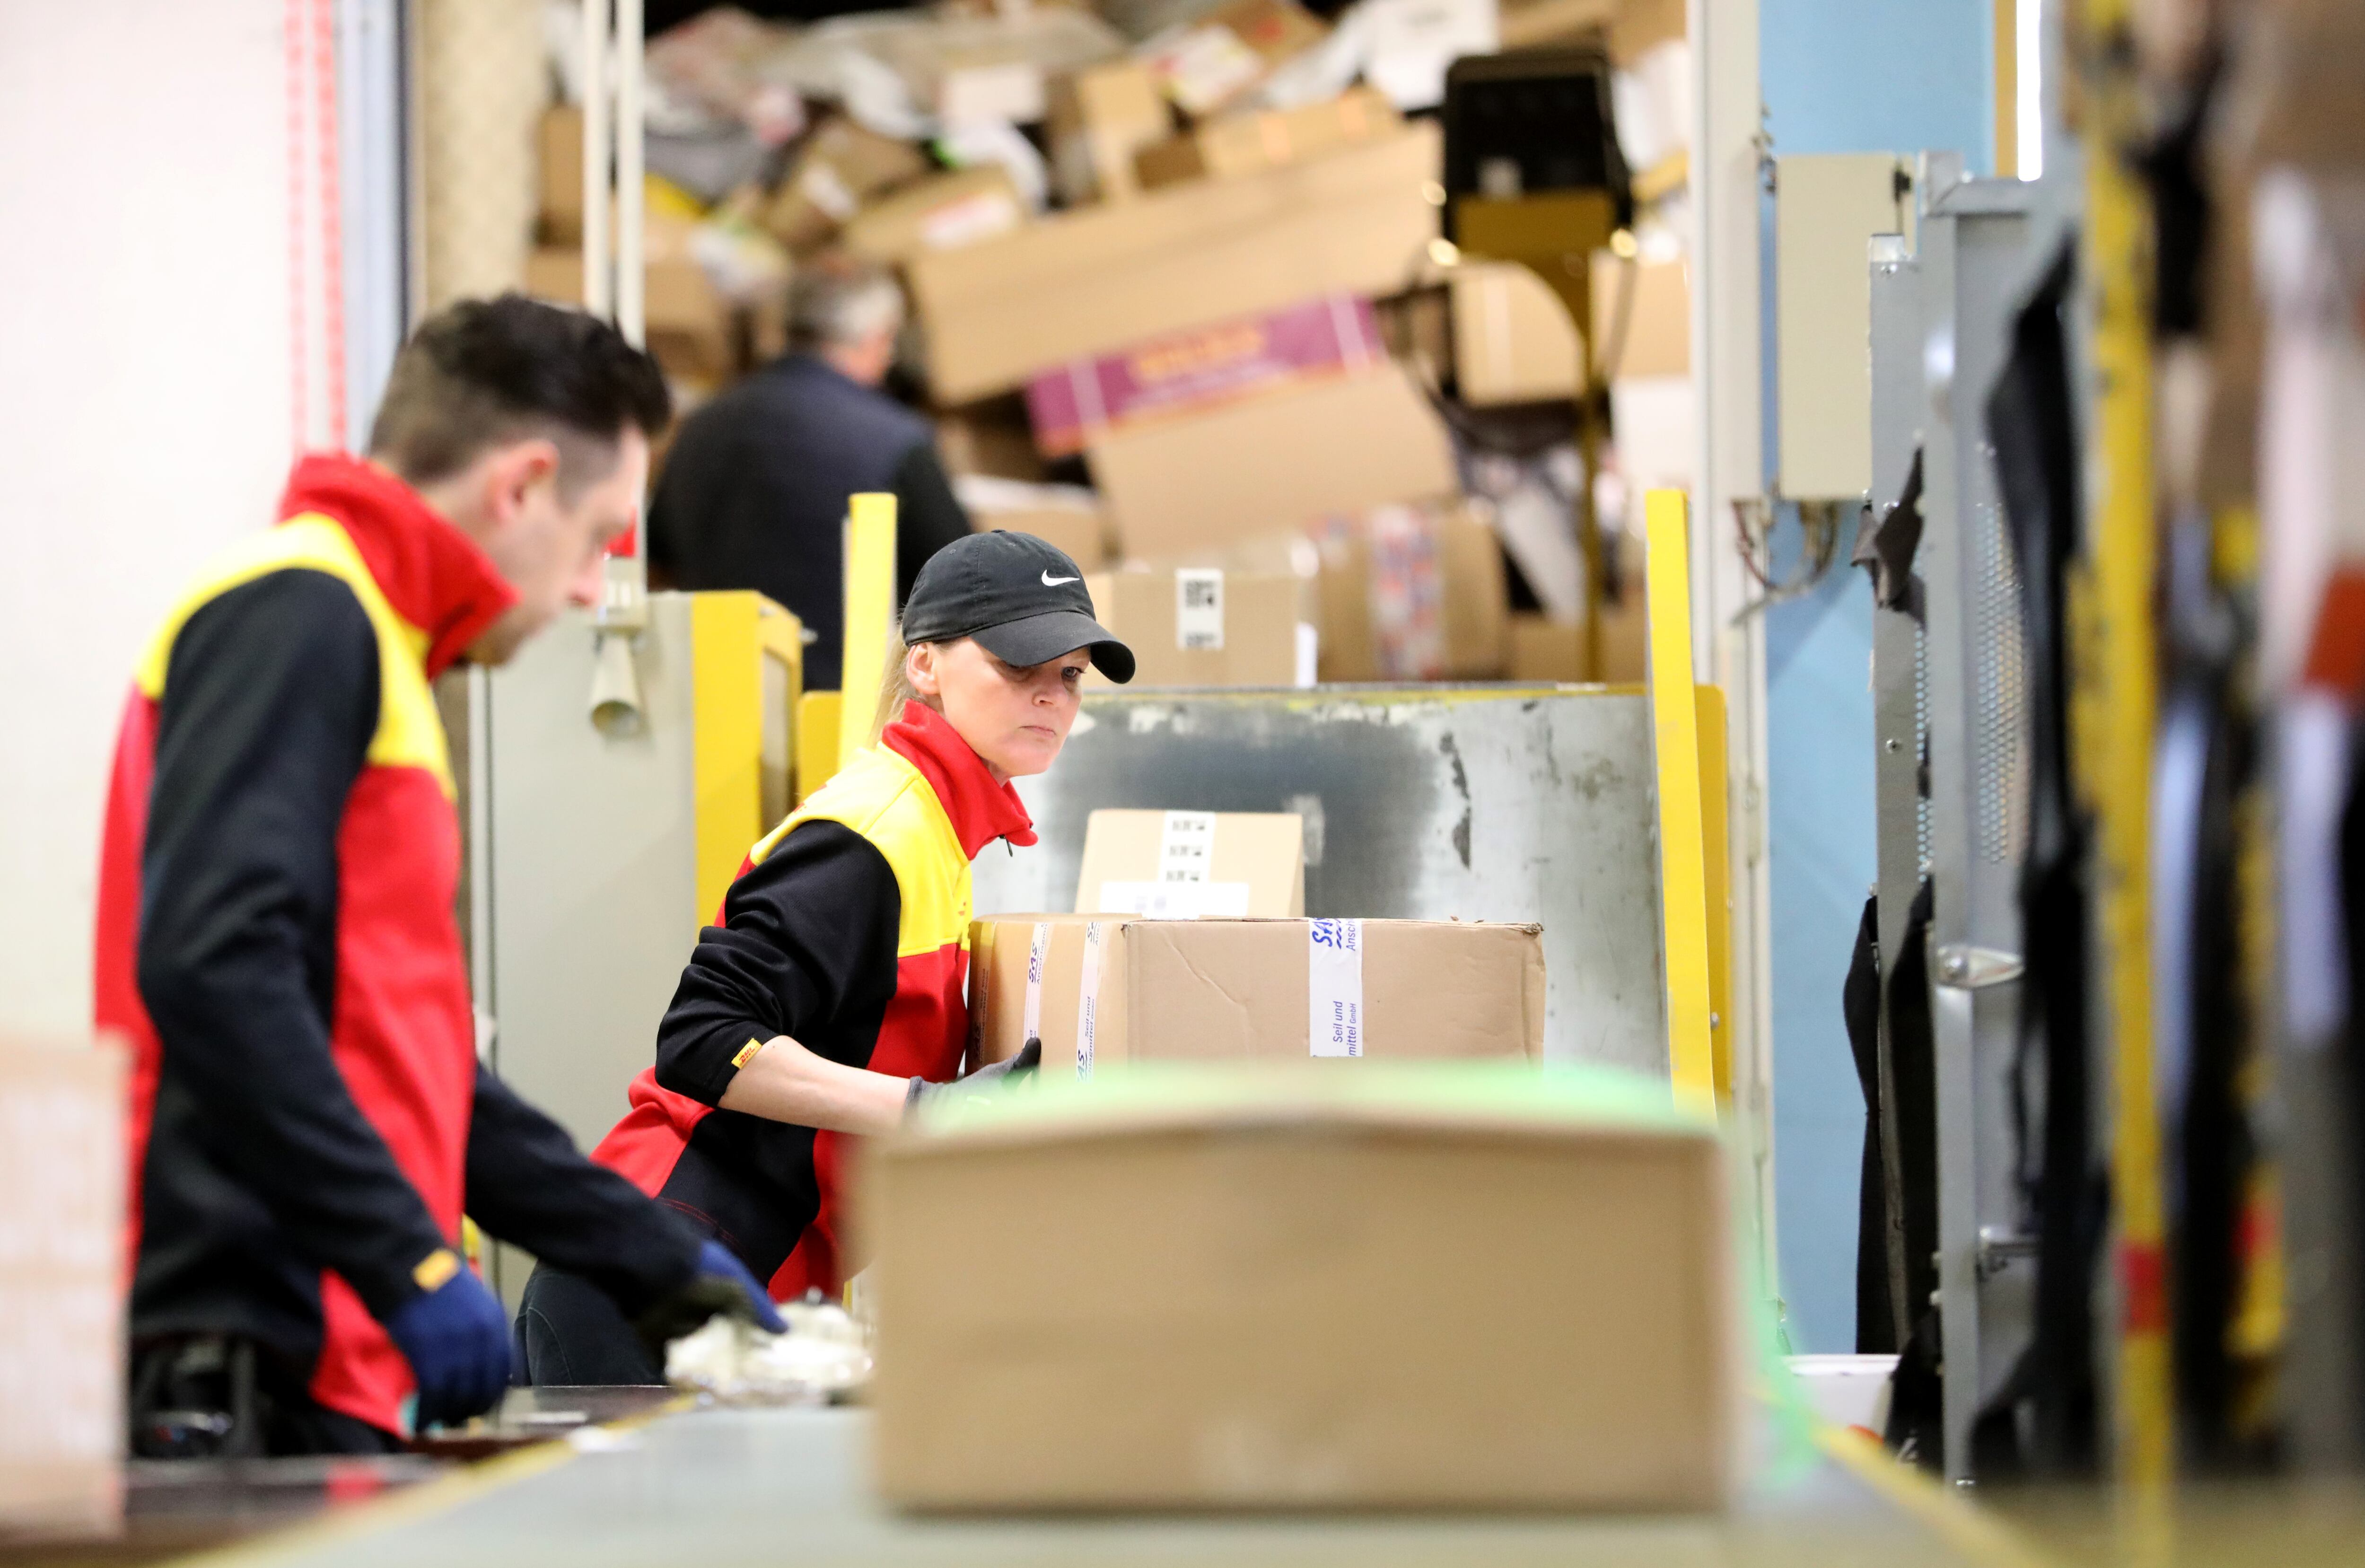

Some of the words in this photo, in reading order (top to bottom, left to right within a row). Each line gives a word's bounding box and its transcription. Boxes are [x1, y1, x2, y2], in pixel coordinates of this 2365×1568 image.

[1333, 1001, 1343, 1021] und
[1333, 1024, 1343, 1042] Seil
[1347, 1026, 1356, 1056] mittel
